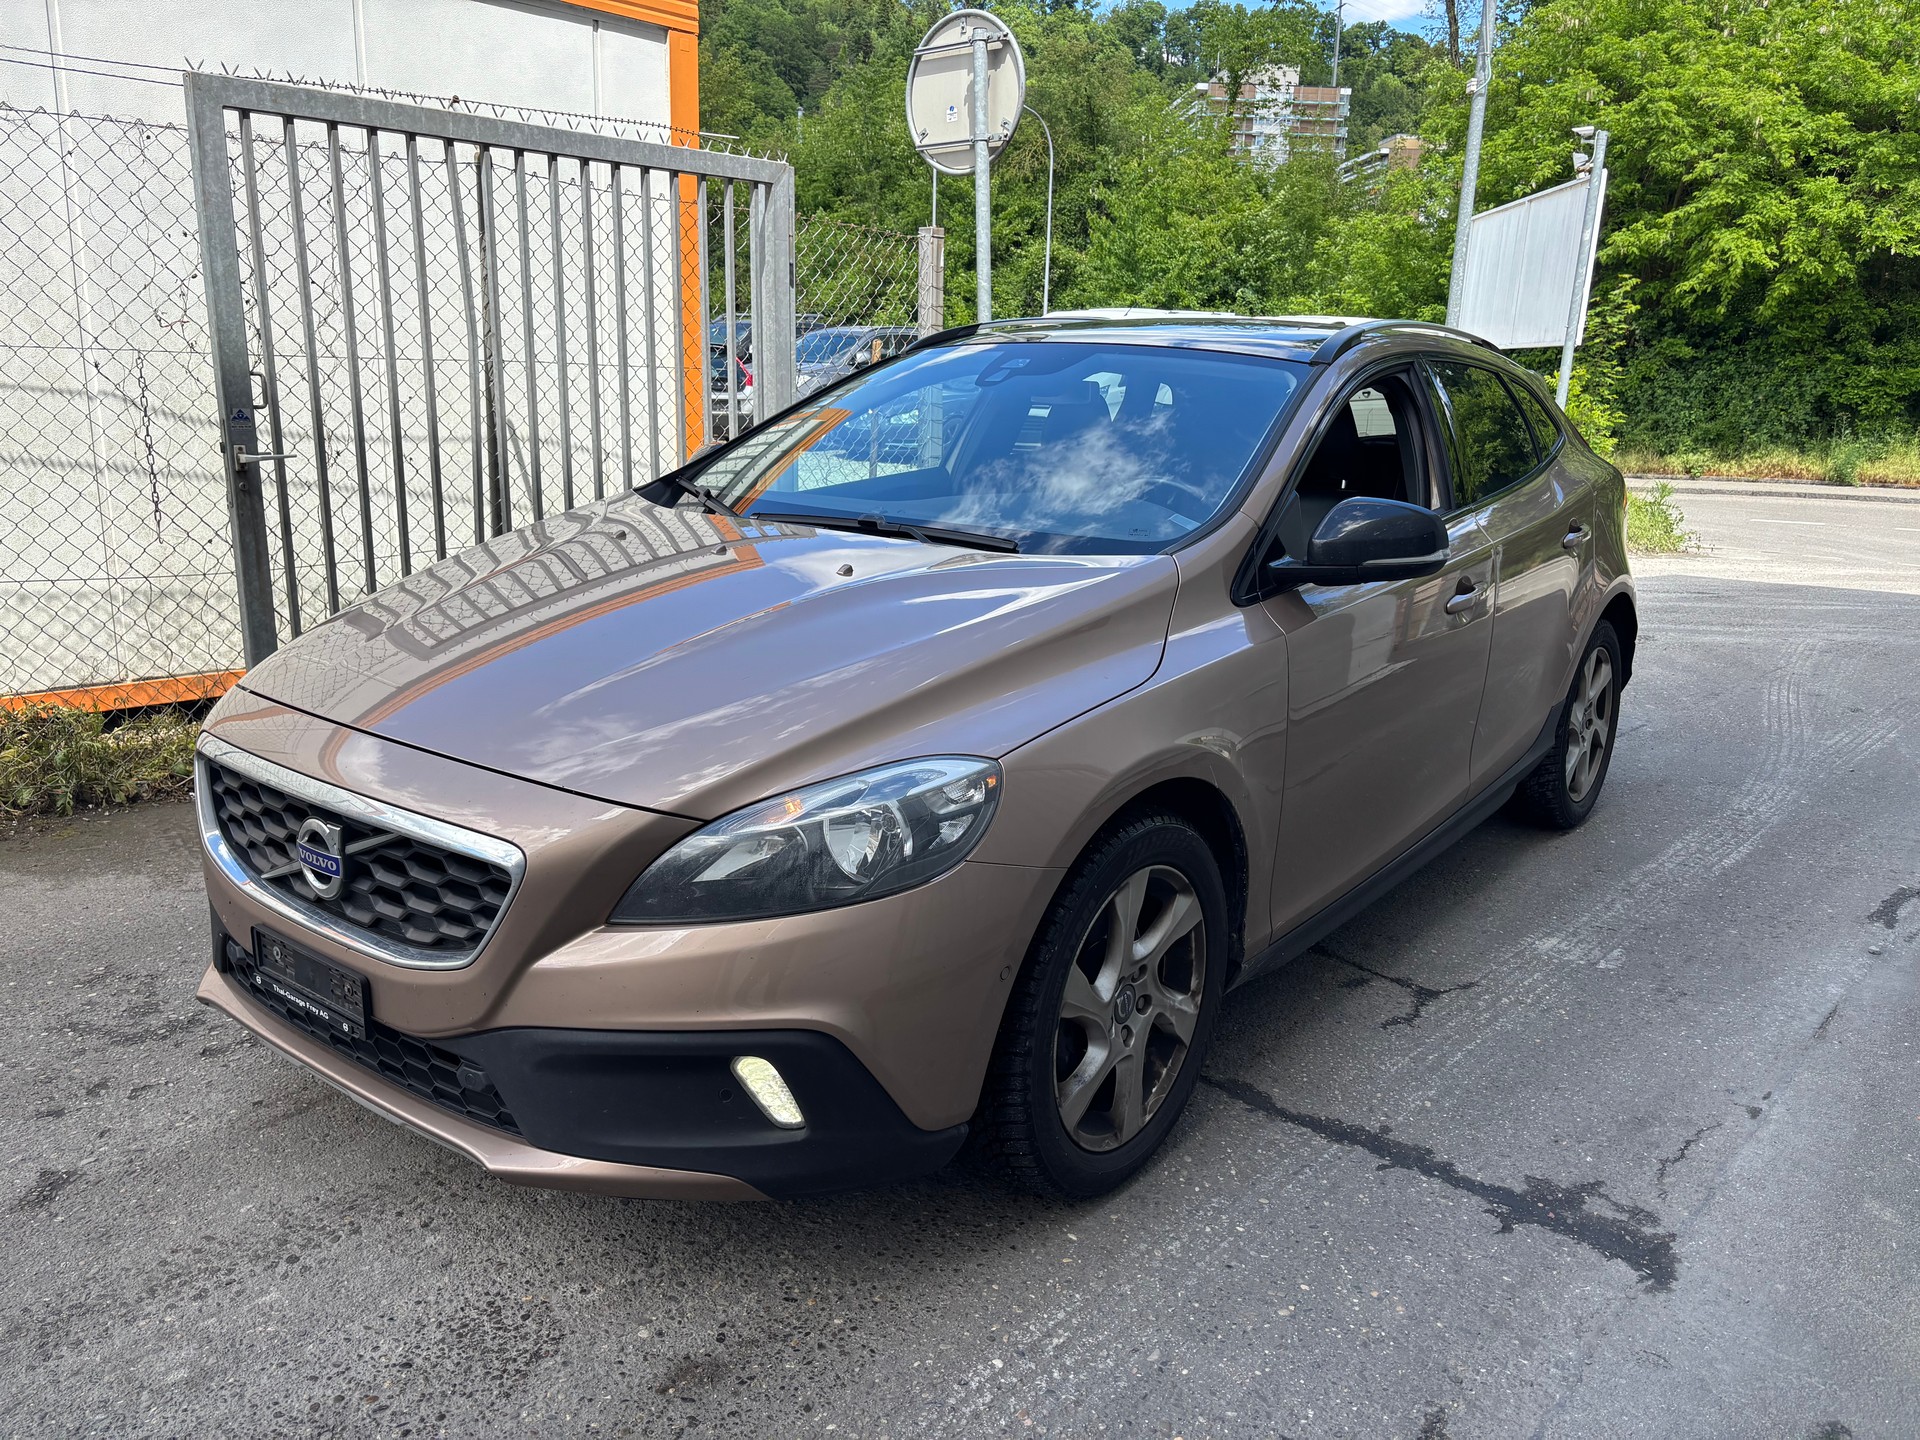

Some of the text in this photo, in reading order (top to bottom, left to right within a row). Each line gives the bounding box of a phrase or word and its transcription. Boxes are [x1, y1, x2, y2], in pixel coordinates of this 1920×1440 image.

[299, 848, 337, 871] VOLVO
[306, 1001, 319, 1016] Frey
[319, 1009, 329, 1020] AG
